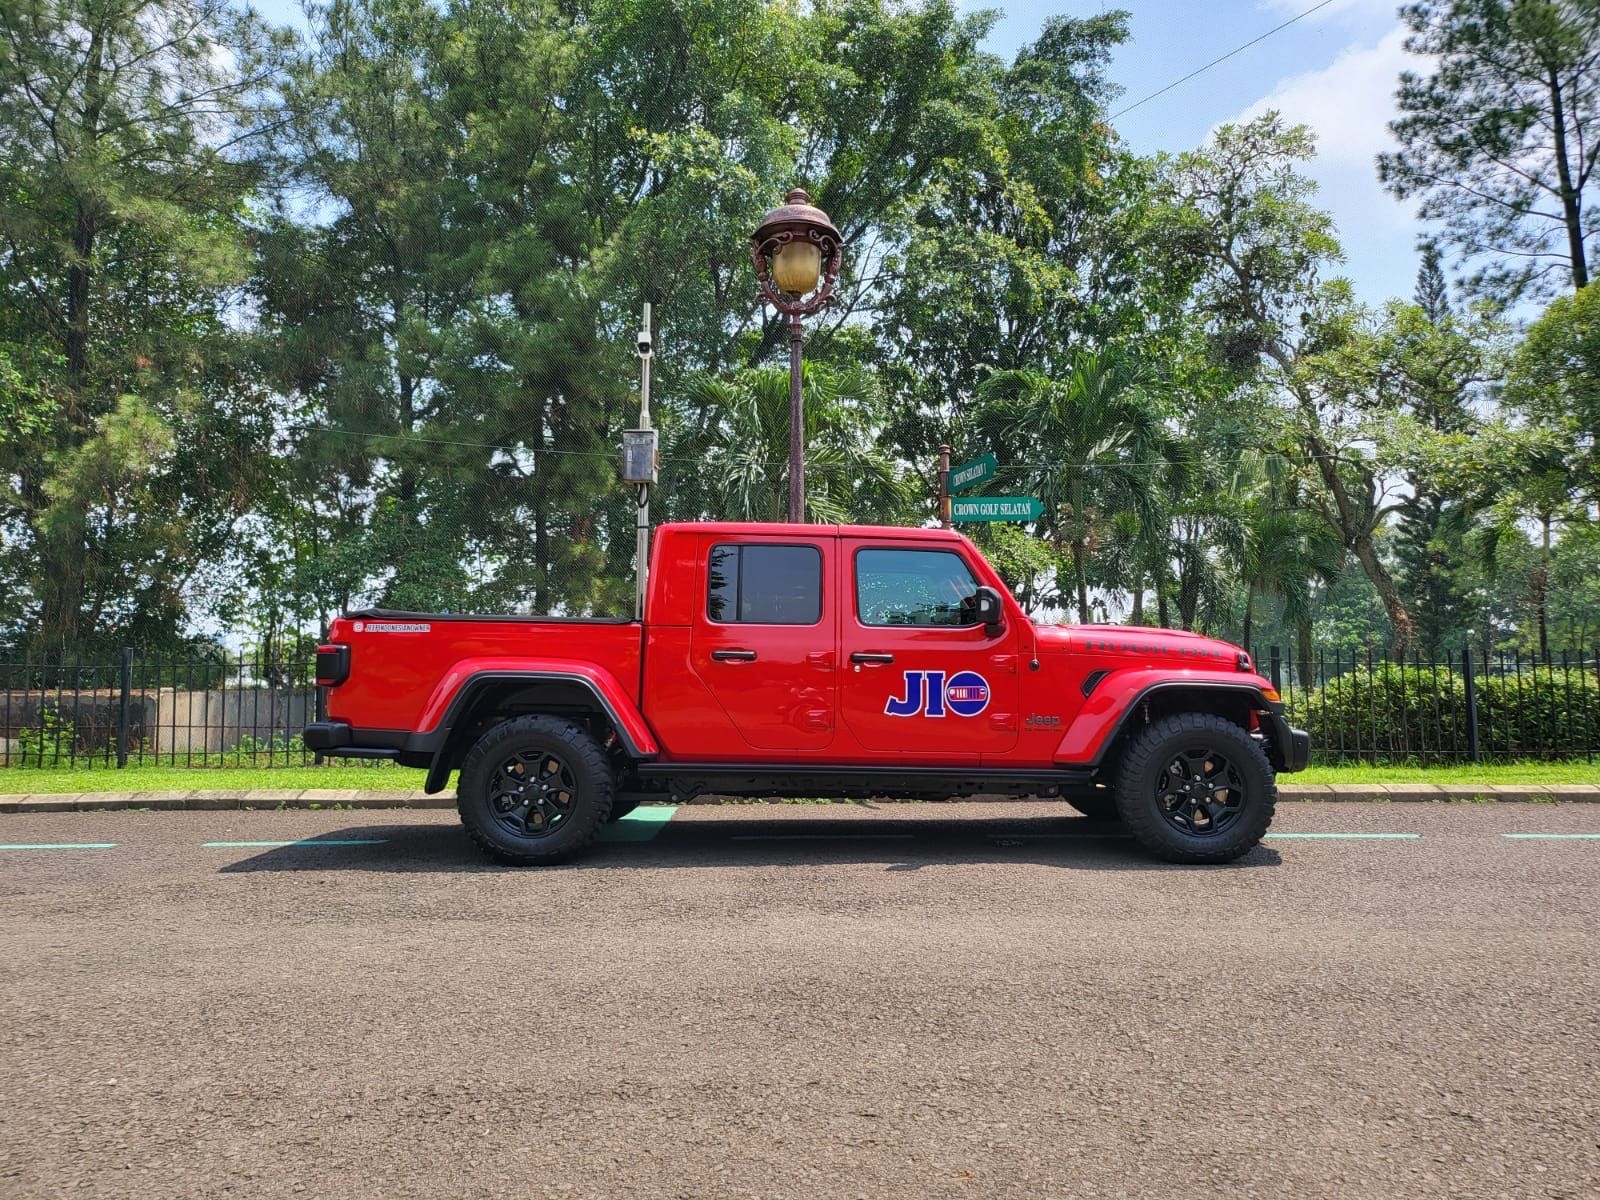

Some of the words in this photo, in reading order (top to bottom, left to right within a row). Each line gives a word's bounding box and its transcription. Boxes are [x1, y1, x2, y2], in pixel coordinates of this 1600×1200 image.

[953, 470, 967, 486] CROWN
[953, 503, 979, 516] CROWN
[980, 503, 999, 515] GOLF
[1000, 502, 1032, 515] SELATAN
[1025, 713, 1060, 727] Jeep
